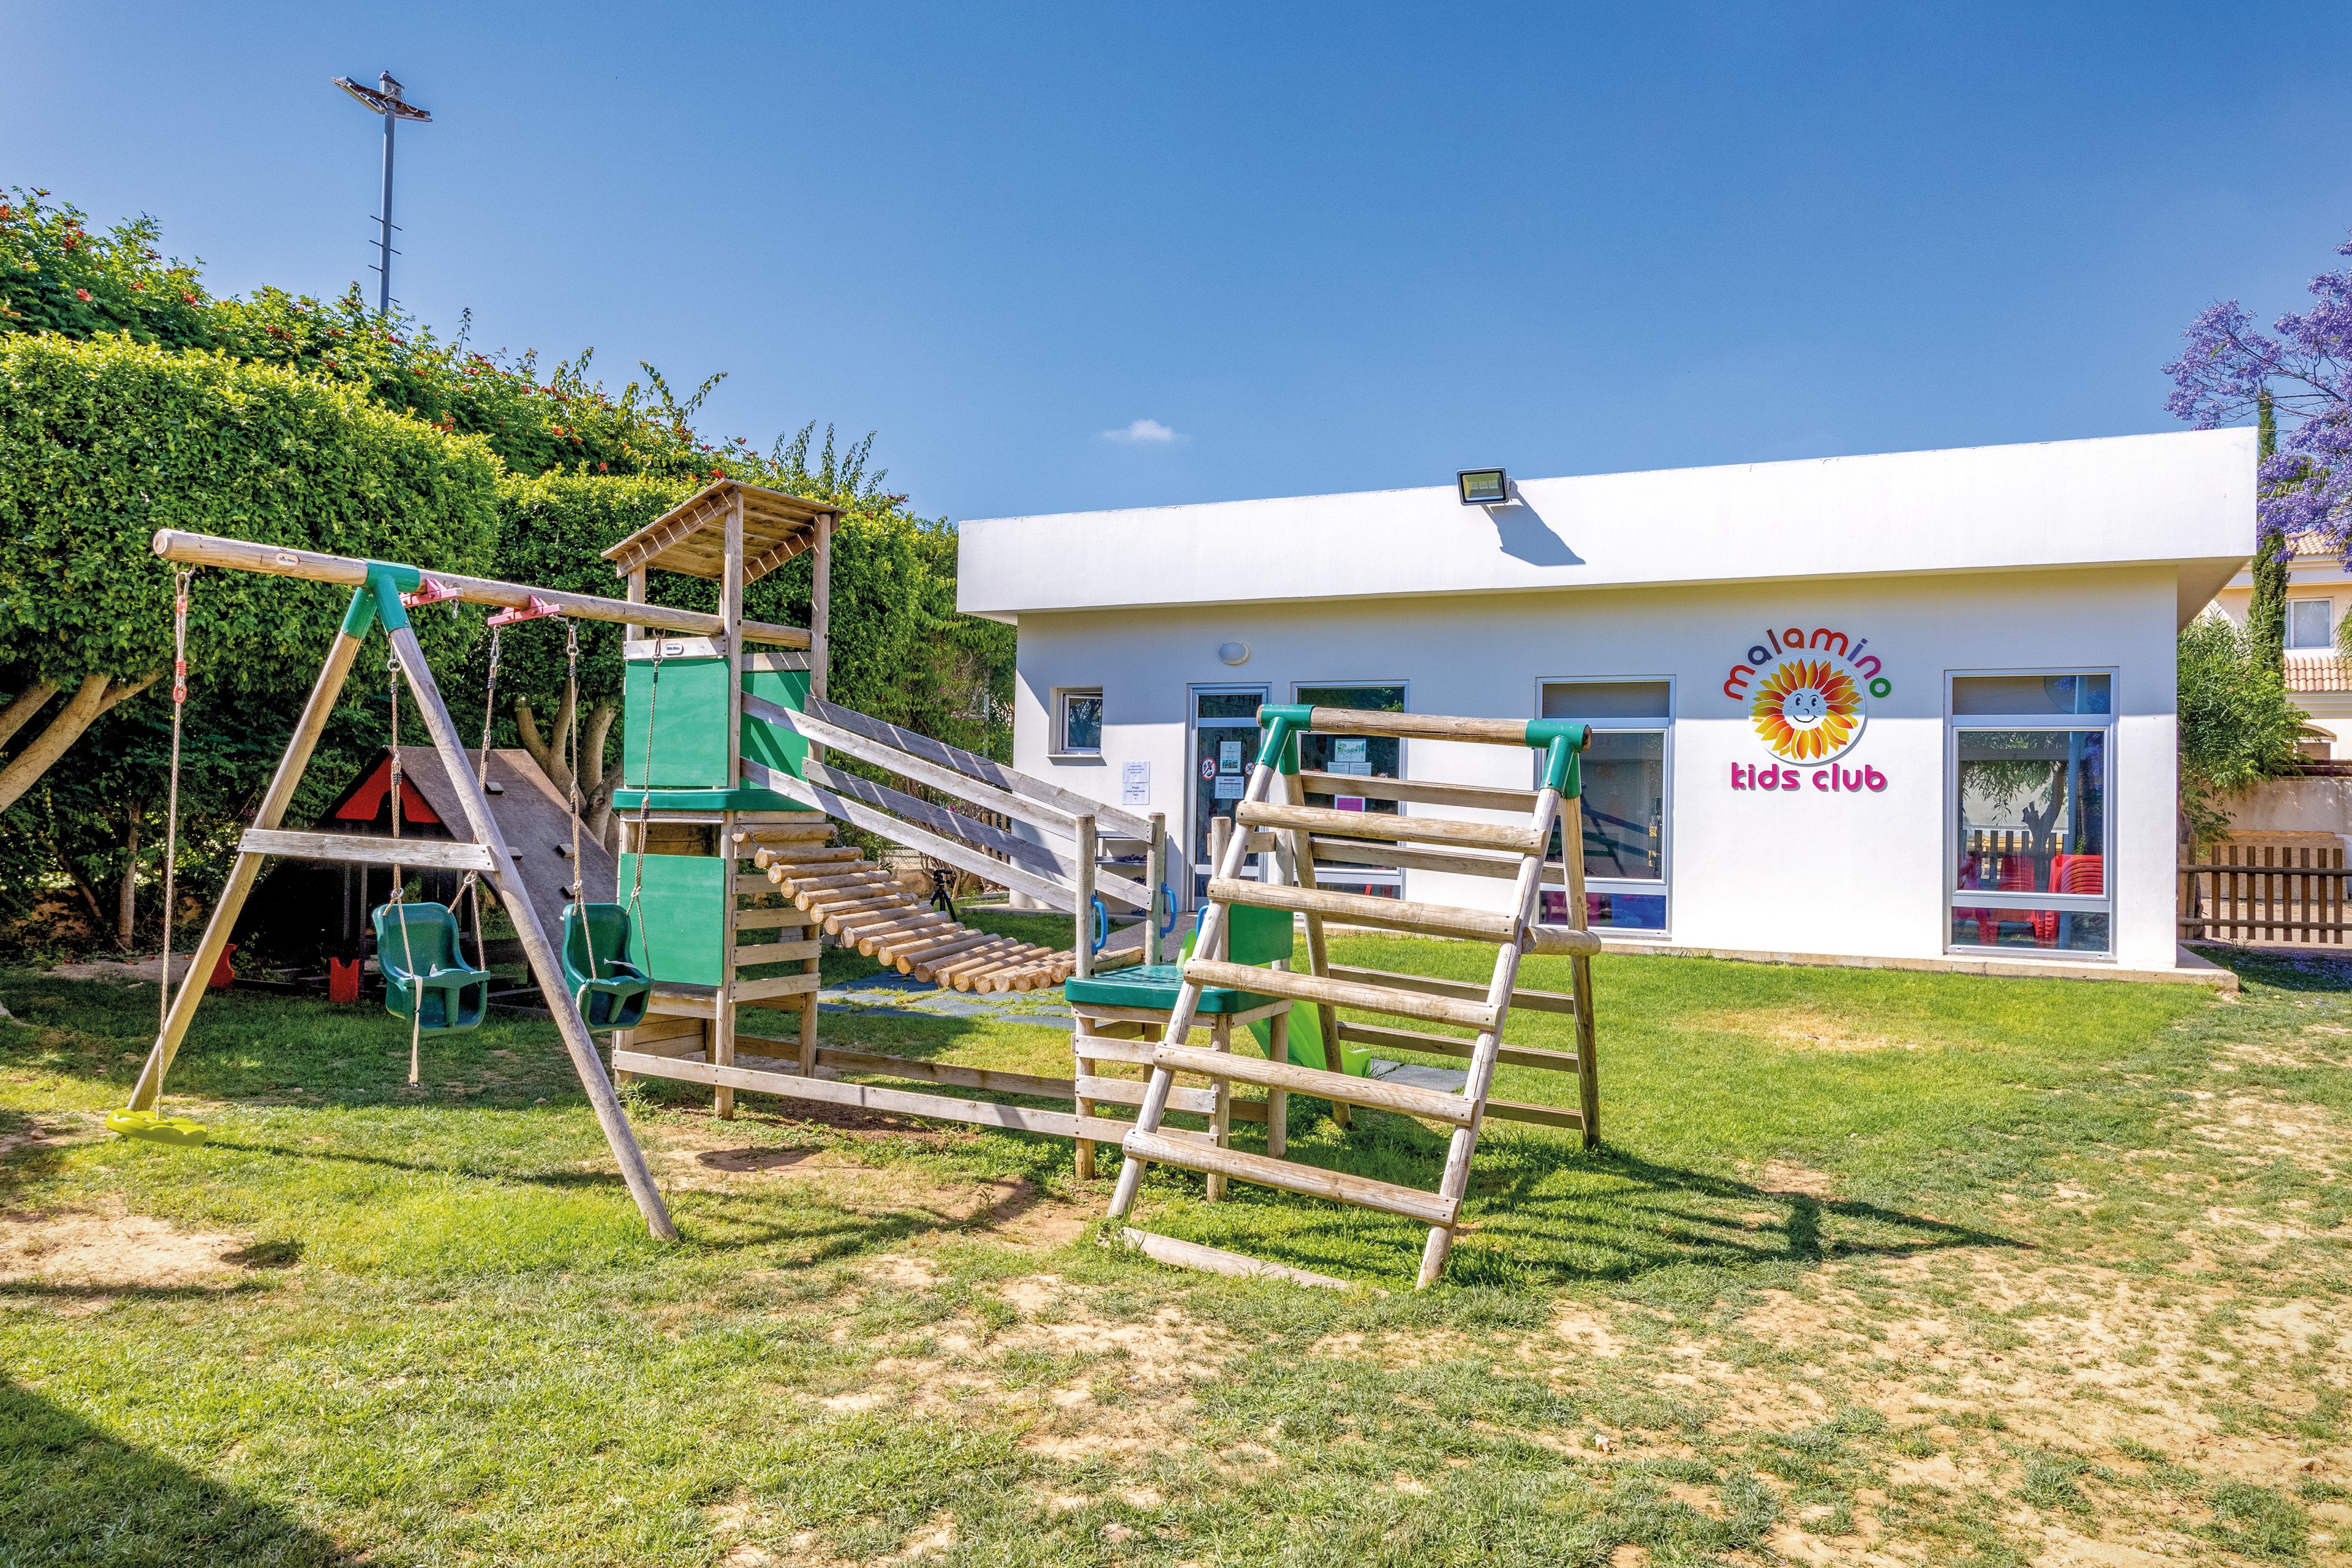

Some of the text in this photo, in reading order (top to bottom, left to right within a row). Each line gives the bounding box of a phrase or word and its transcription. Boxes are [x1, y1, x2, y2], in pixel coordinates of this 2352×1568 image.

[1724, 628, 1891, 700] malamino
[1732, 762, 1887, 790] kids club
